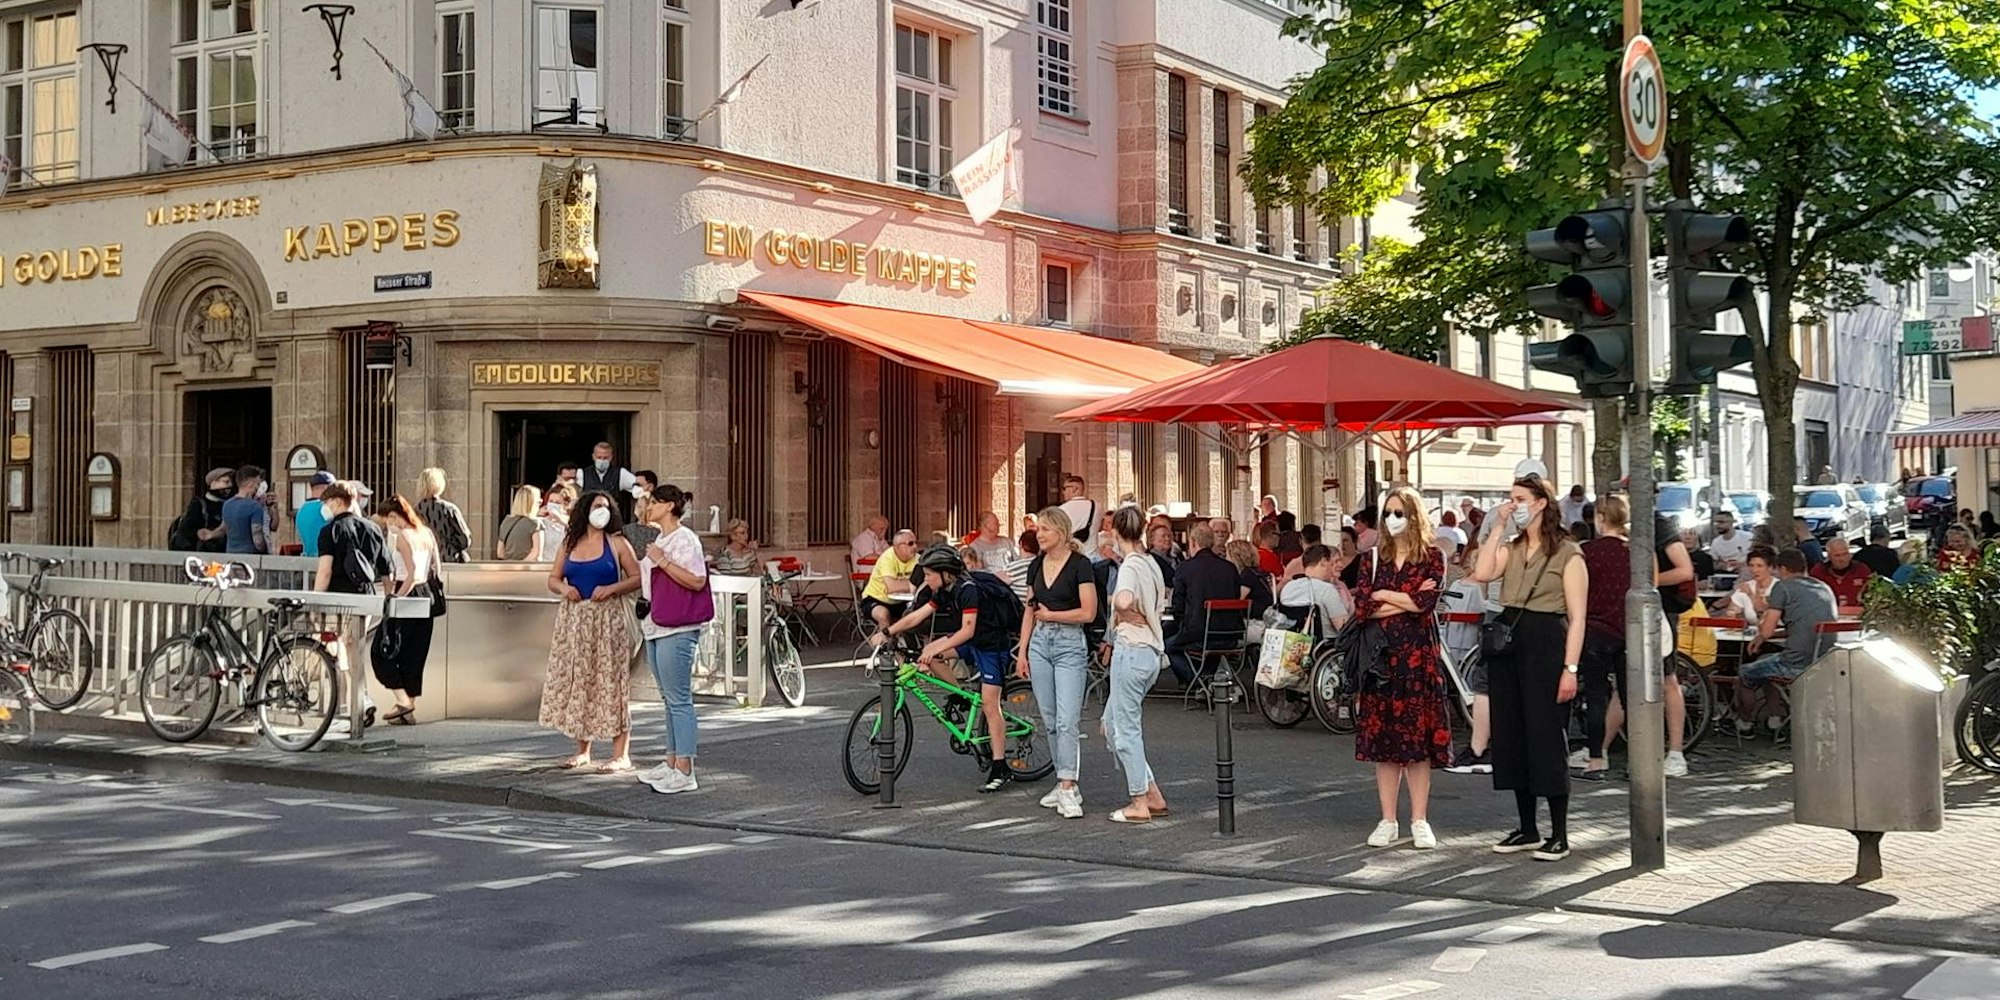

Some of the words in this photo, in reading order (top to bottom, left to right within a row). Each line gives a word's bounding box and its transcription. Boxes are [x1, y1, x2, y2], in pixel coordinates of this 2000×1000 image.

[1632, 71, 1656, 129] 30
[960, 163, 984, 185] KEIN
[284, 209, 461, 263] KAPPES
[13, 242, 123, 284] GOLDE
[704, 218, 755, 261] EM
[765, 228, 868, 277] GOLDE
[877, 245, 978, 294] KAPPES
[404, 274, 425, 286] Straße
[1911, 321, 1947, 330] PIZZA
[474, 364, 501, 385] EM
[505, 364, 577, 385] GOLDE
[580, 364, 659, 386] KAPPES
